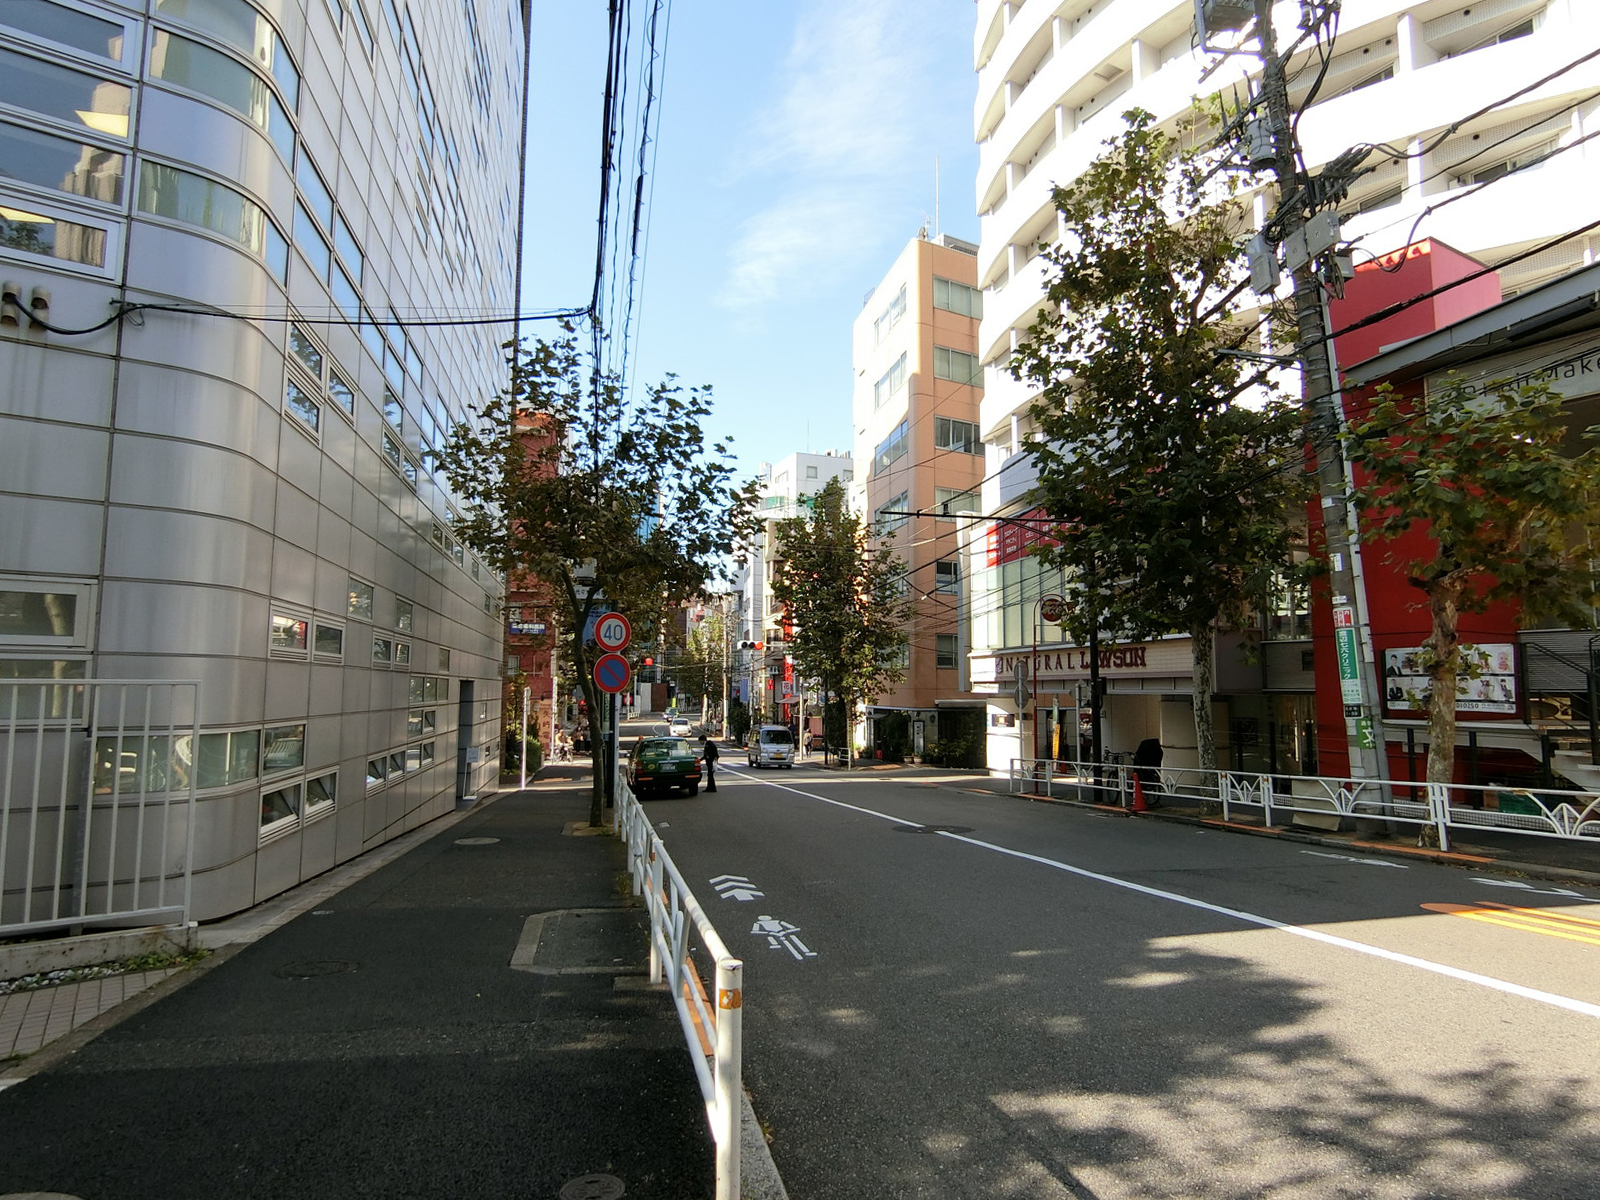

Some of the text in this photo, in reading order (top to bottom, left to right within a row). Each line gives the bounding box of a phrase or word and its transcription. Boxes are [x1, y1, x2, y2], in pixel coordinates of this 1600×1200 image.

[603, 624, 623, 641] 40
[1005, 647, 1147, 673] NTURAL LWSON
